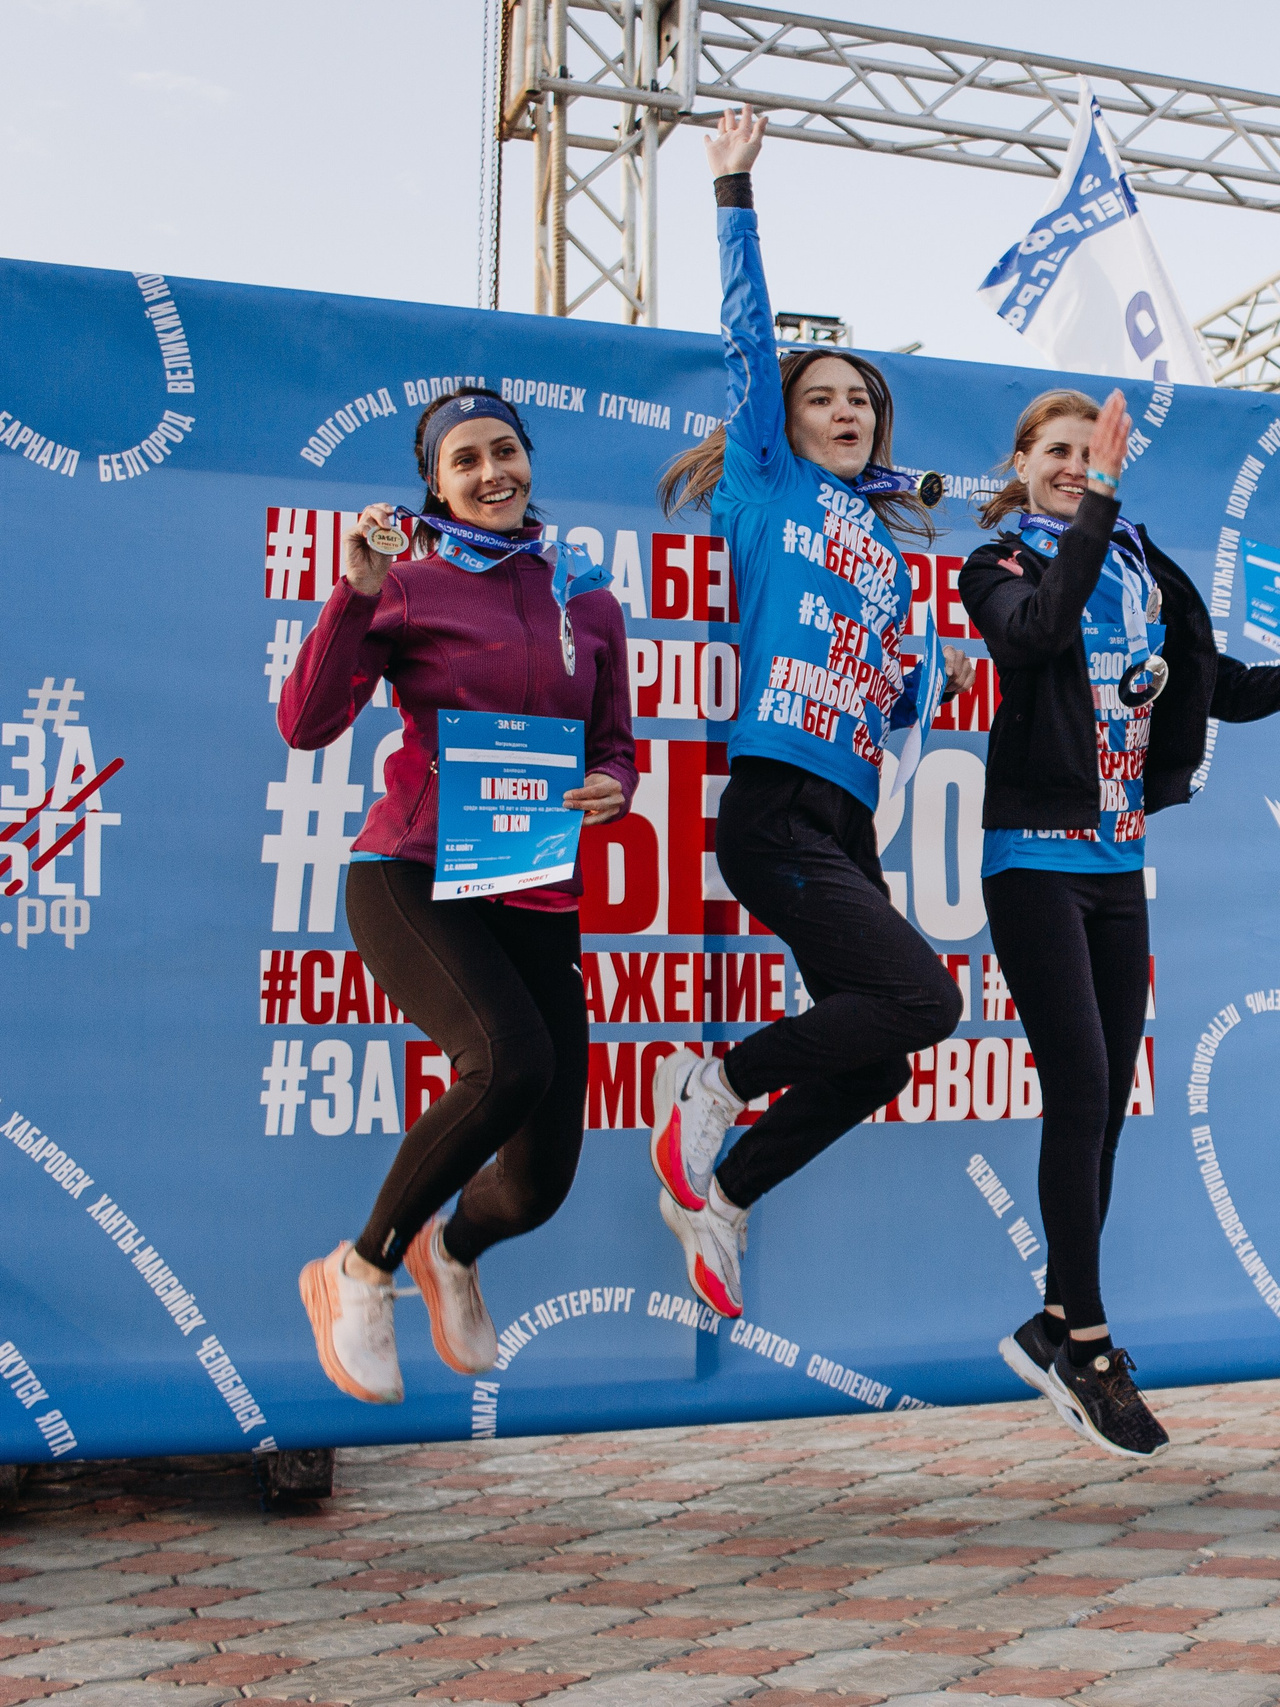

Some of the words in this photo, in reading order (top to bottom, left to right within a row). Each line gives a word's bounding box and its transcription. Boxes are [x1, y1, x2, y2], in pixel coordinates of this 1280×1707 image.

[144, 299, 196, 394] ВЕЛИКИЙ
[98, 409, 197, 483] БЕЛГОРОД
[300, 386, 397, 469] ВОЛГОГРАД
[501, 376, 587, 414] ВОРОНЕЖ
[598, 392, 672, 432] ГАТЧИНА
[817, 482, 876, 533] 2024
[1225, 453, 1267, 520] МАЙКОП
[459, 551, 486, 570] ПСБ
[822, 508, 899, 589] #МЕЧТА
[1210, 526, 1241, 619] МАХАЧКАЛА
[757, 688, 841, 744] #ЗАБЕГ
[493, 814, 508, 832] 10
[494, 777, 549, 801] МЕСТО
[1188, 1002, 1243, 1117] ПЕТРОЗАВОДСК
[965, 1152, 1015, 1220] ТЮМЕНЬ
[1006, 1215, 1042, 1262] ТУЛА
[0, 1110, 96, 1201] ХАБАРОВСК
[85, 1192, 208, 1338] ХАНТЫ-МАНСИЙСК
[195, 1333, 268, 1435] ЧЕЛЯБИНСК
[646, 1289, 722, 1336] САРАНСК
[730, 1318, 801, 1369] САРАТОВ
[806, 1352, 893, 1411] СМОЛЕНСК
[35, 1408, 78, 1458] ЯЛТА
